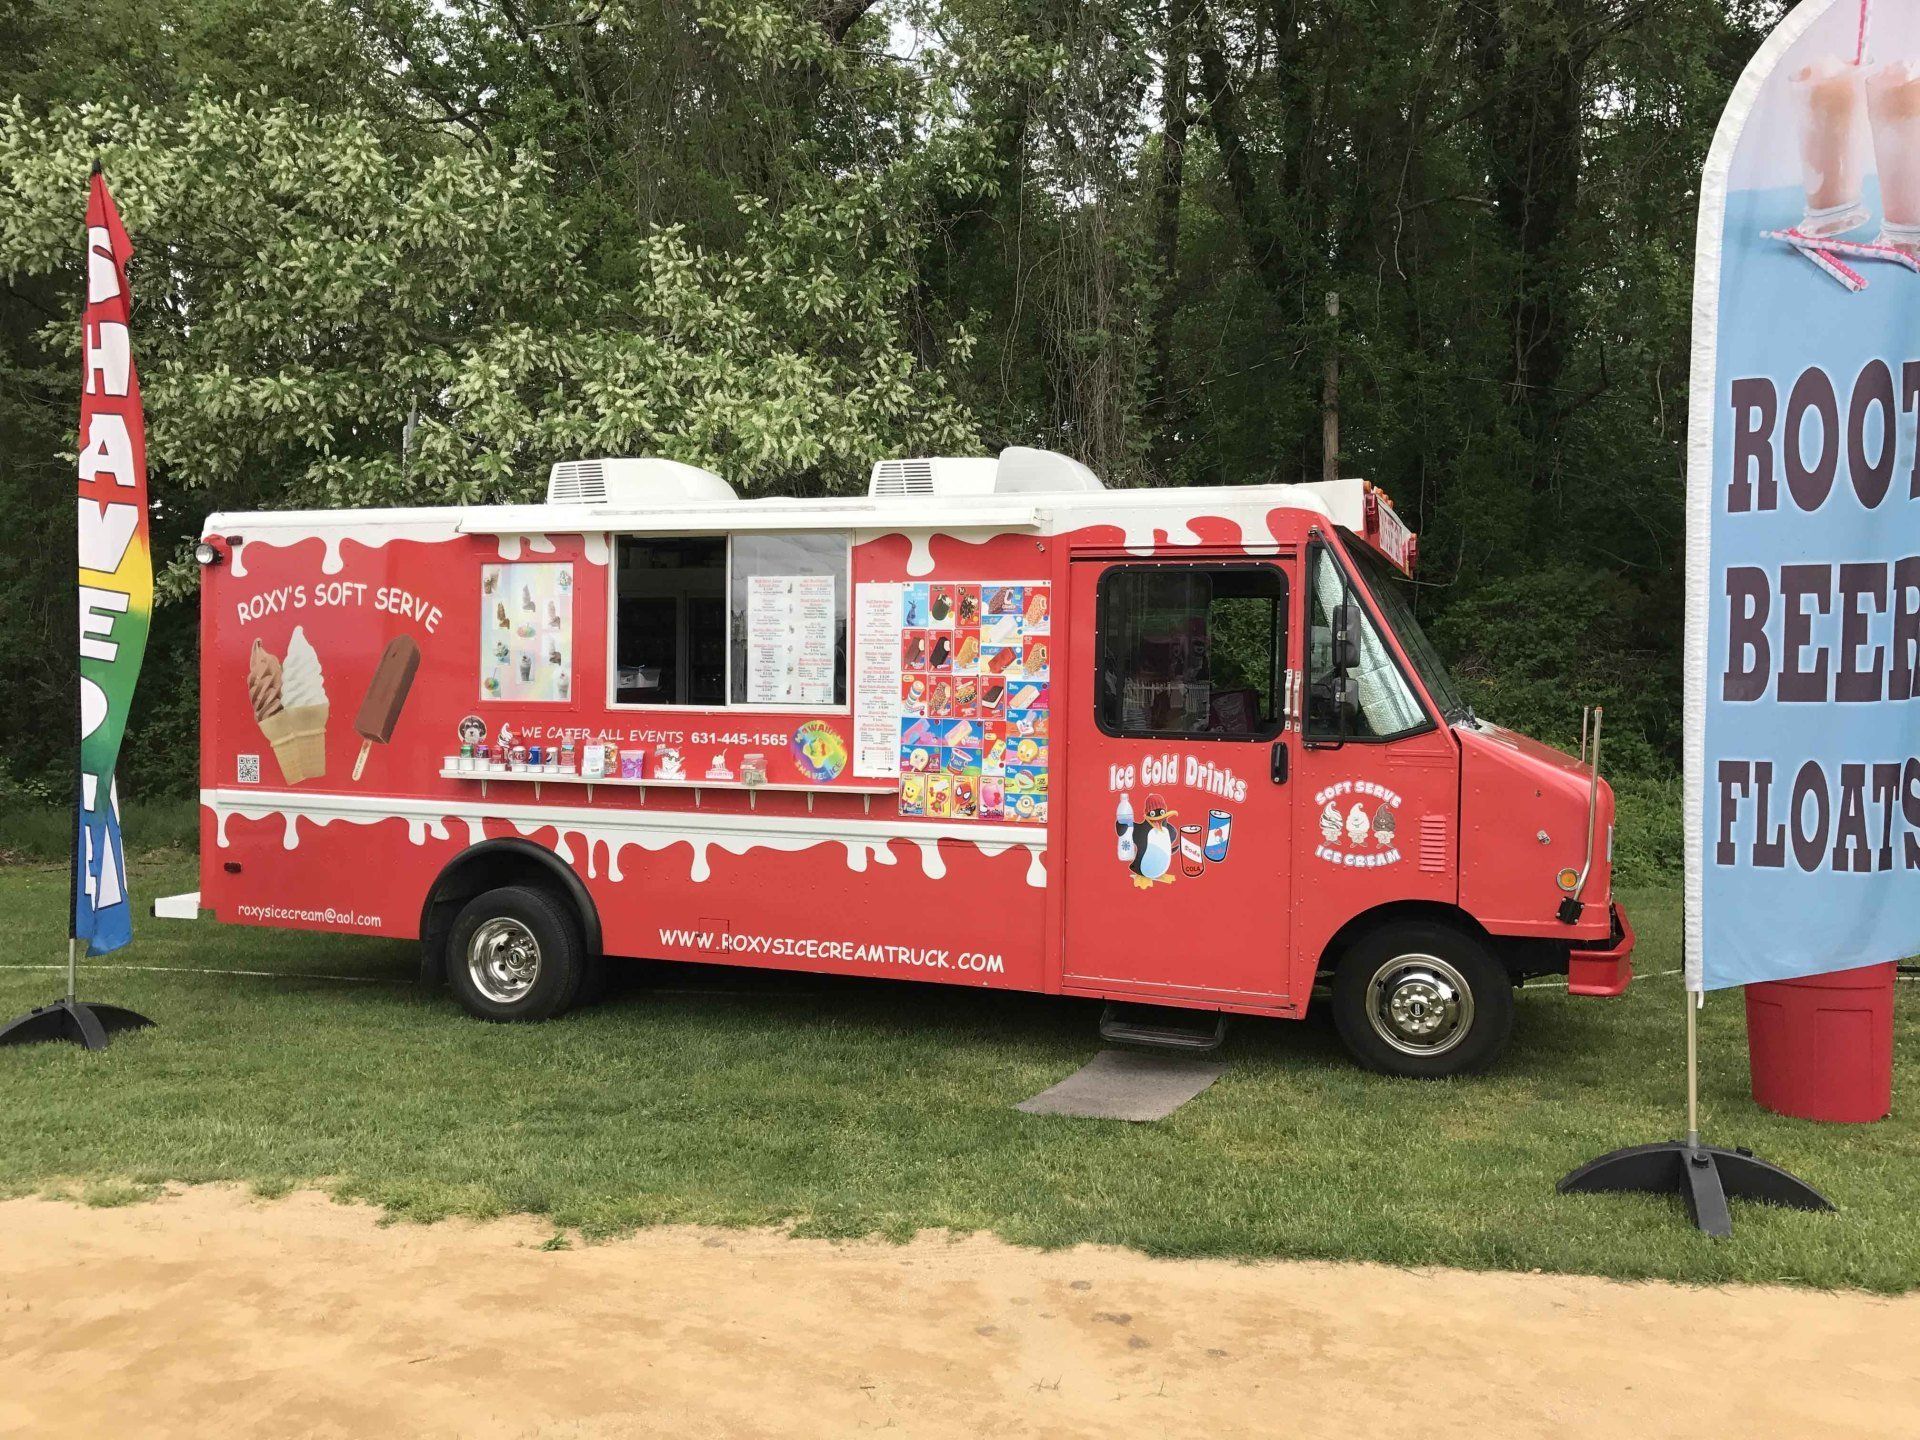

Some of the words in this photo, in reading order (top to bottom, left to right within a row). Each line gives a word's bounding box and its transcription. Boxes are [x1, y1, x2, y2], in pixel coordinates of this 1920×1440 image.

[236, 584, 307, 625] ROXY'S
[313, 581, 368, 606] SOFT
[374, 587, 443, 634] SERVE
[1723, 556, 1920, 703] BEER
[521, 726, 542, 738] WE
[546, 727, 592, 740] CATER
[598, 728, 624, 741] ALL
[629, 730, 684, 743] EVENTS
[691, 732, 788, 746] 631-445-1565
[1109, 764, 1134, 791] Ice
[1141, 753, 1178, 786] Cold
[1185, 755, 1246, 802] Drinks
[1315, 781, 1352, 805] SOFT
[1354, 780, 1401, 808] SERVE
[1716, 757, 1920, 872] FLOATS
[1315, 845, 1342, 864] ICE
[1343, 848, 1401, 867] CREAM
[238, 904, 382, 927] roxysicecream@aol.com
